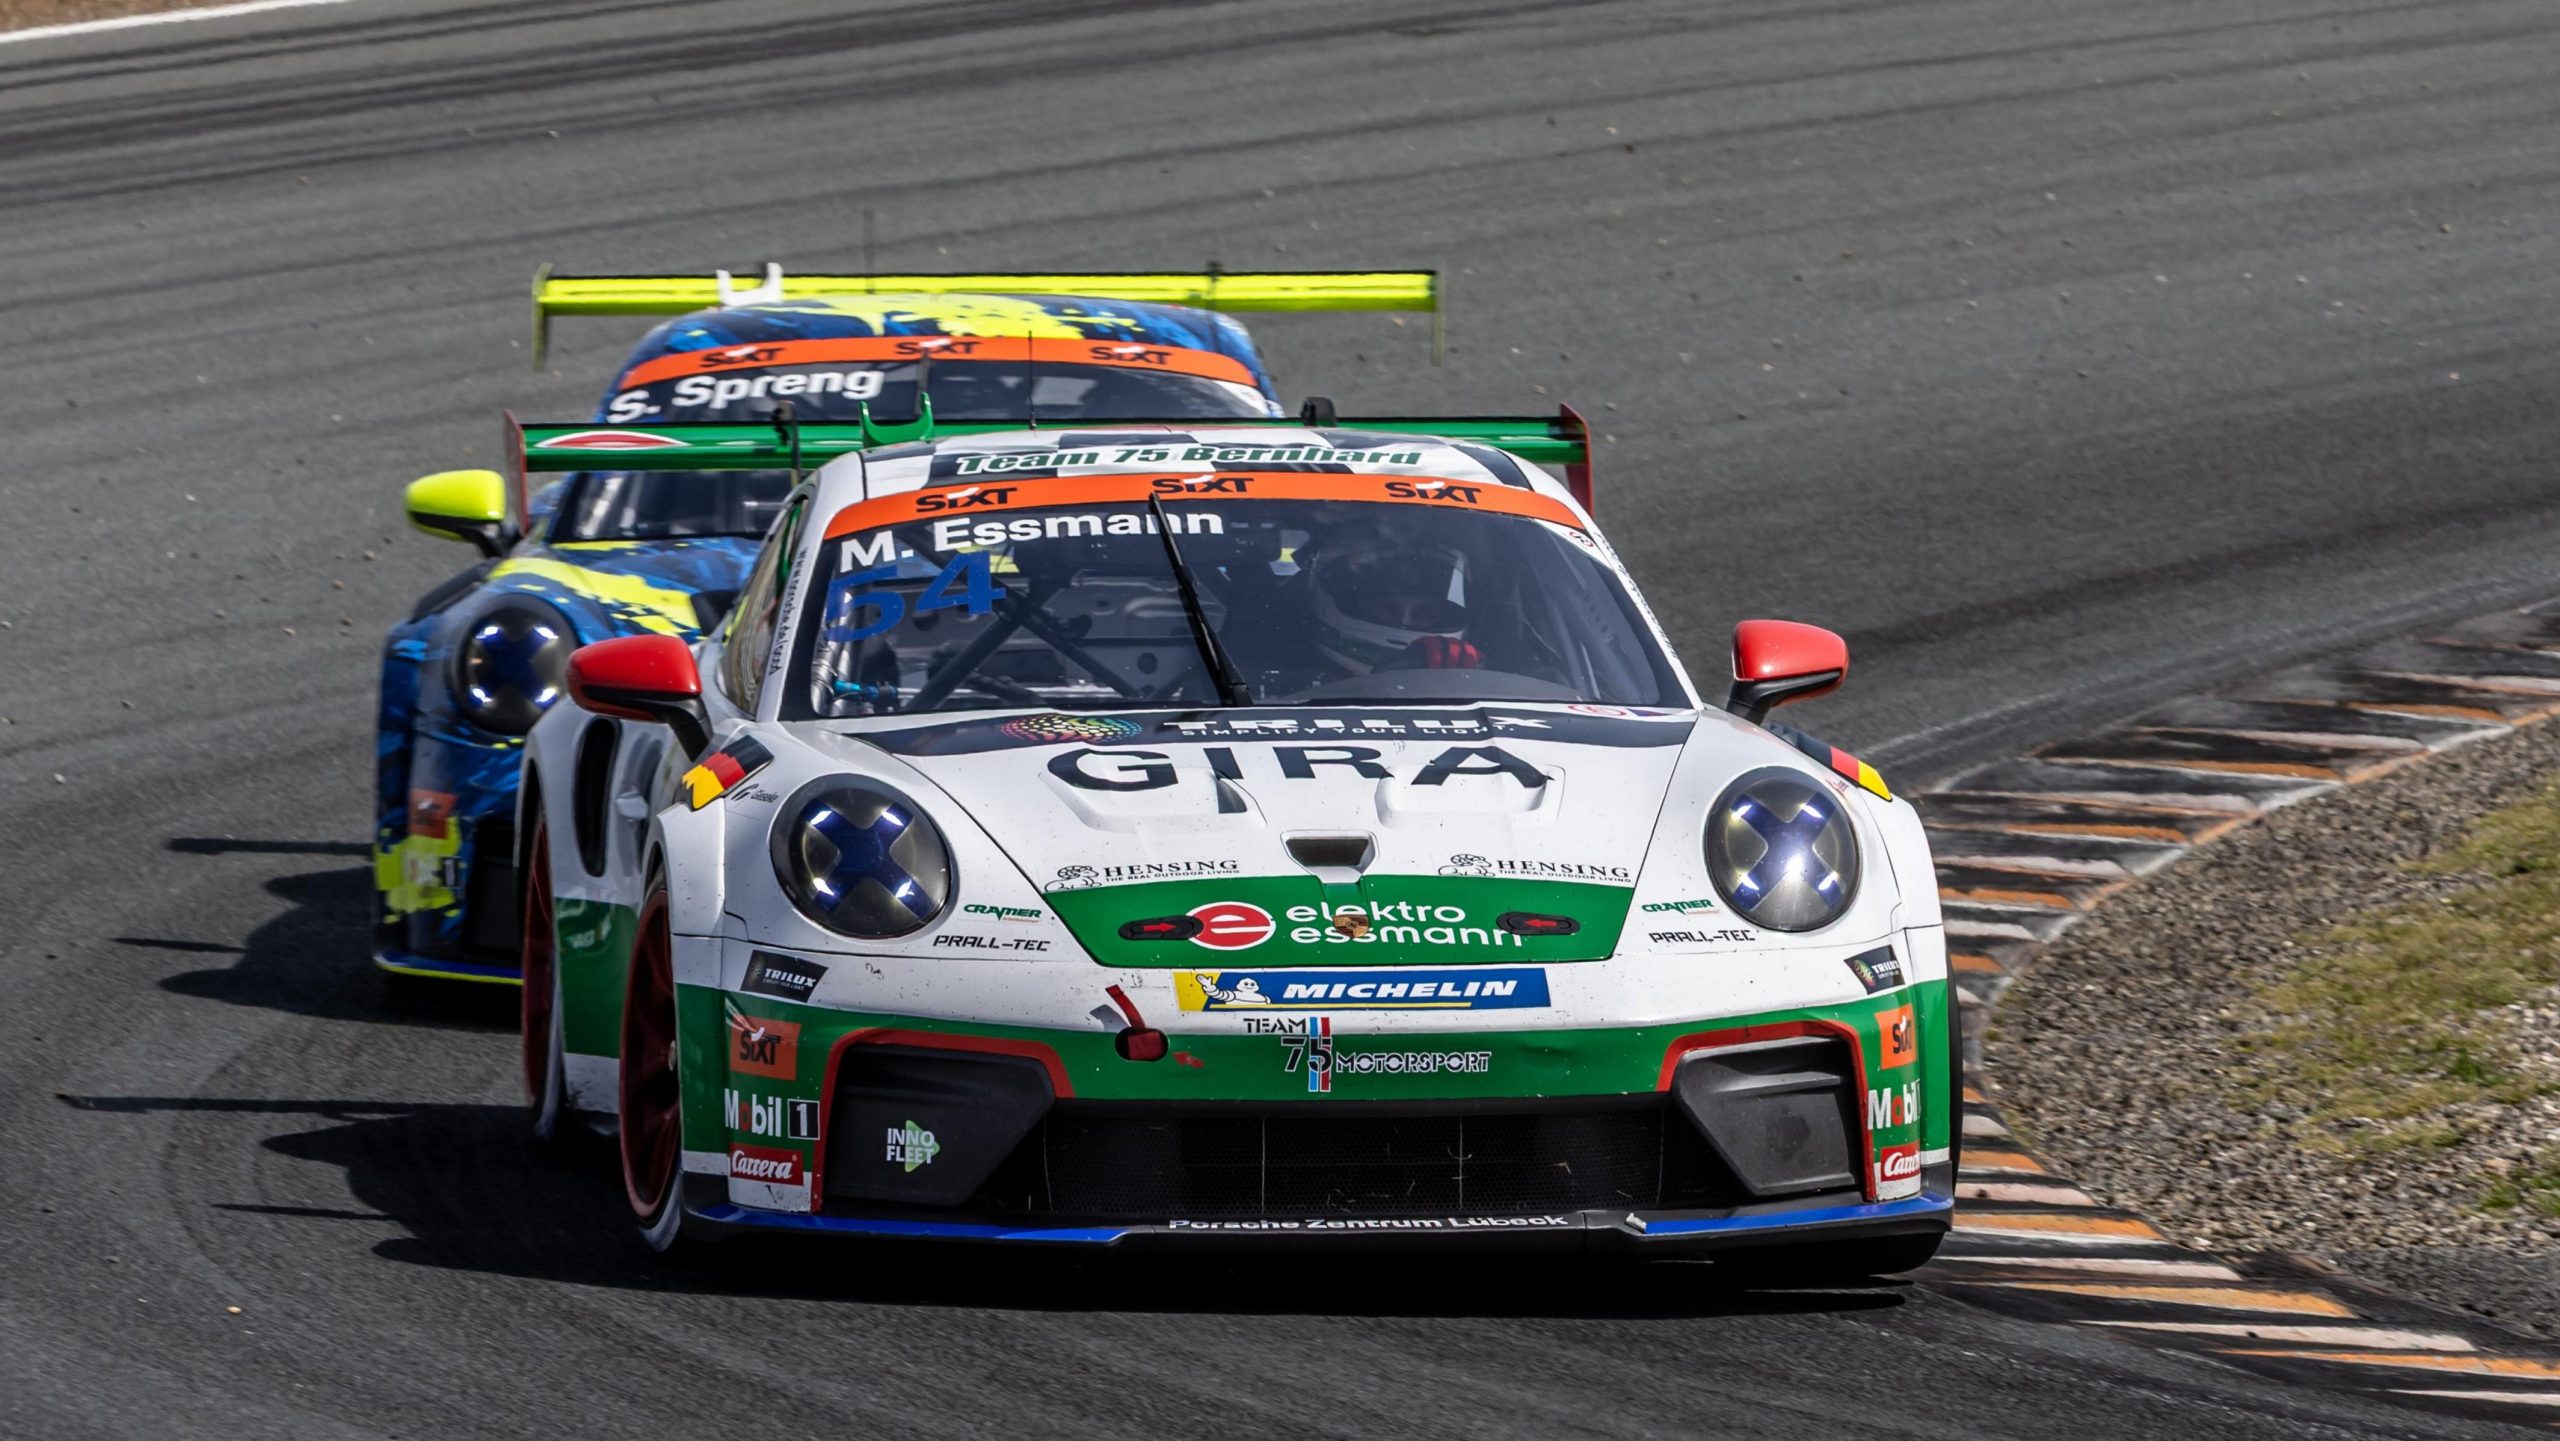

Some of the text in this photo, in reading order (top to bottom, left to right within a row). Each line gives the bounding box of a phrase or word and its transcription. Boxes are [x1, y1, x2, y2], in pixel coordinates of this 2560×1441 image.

[606, 369, 886, 424] S. Spreng
[955, 445, 1424, 476] Team 75 Bernhard
[839, 511, 1225, 574] M. Essmann
[822, 549, 1007, 643] 54
[1181, 725, 1319, 737] SIMPLIFY
[1332, 726, 1408, 735] YOUR
[1046, 745, 1556, 815] GIRA
[1103, 859, 1240, 878] HENSING
[1496, 859, 1630, 879] HENSING
[1547, 872, 1597, 881] OUTDOOR
[1599, 876, 1632, 884] LIVING
[963, 904, 1042, 921] CRAMER
[1285, 901, 1467, 924] elektro
[1641, 899, 1715, 916] CRAMER
[932, 934, 1051, 952] PRALL-TEC
[1290, 923, 1524, 948] essmann
[1648, 929, 1756, 944] PRALL-TEC
[764, 967, 817, 987] TRILUX
[1282, 980, 1519, 1000] MICHELIN
[1243, 1017, 1307, 1035] TEAM
[1280, 1036, 1493, 1074] 75 MOTORSPORT
[724, 1087, 809, 1138] Mobil 1
[886, 1127, 935, 1148] INNO
[886, 1144, 935, 1164] FLEET
[731, 1150, 793, 1181] Carrera
[1168, 1214, 1569, 1230] Porsche Zentrum Lübeck
